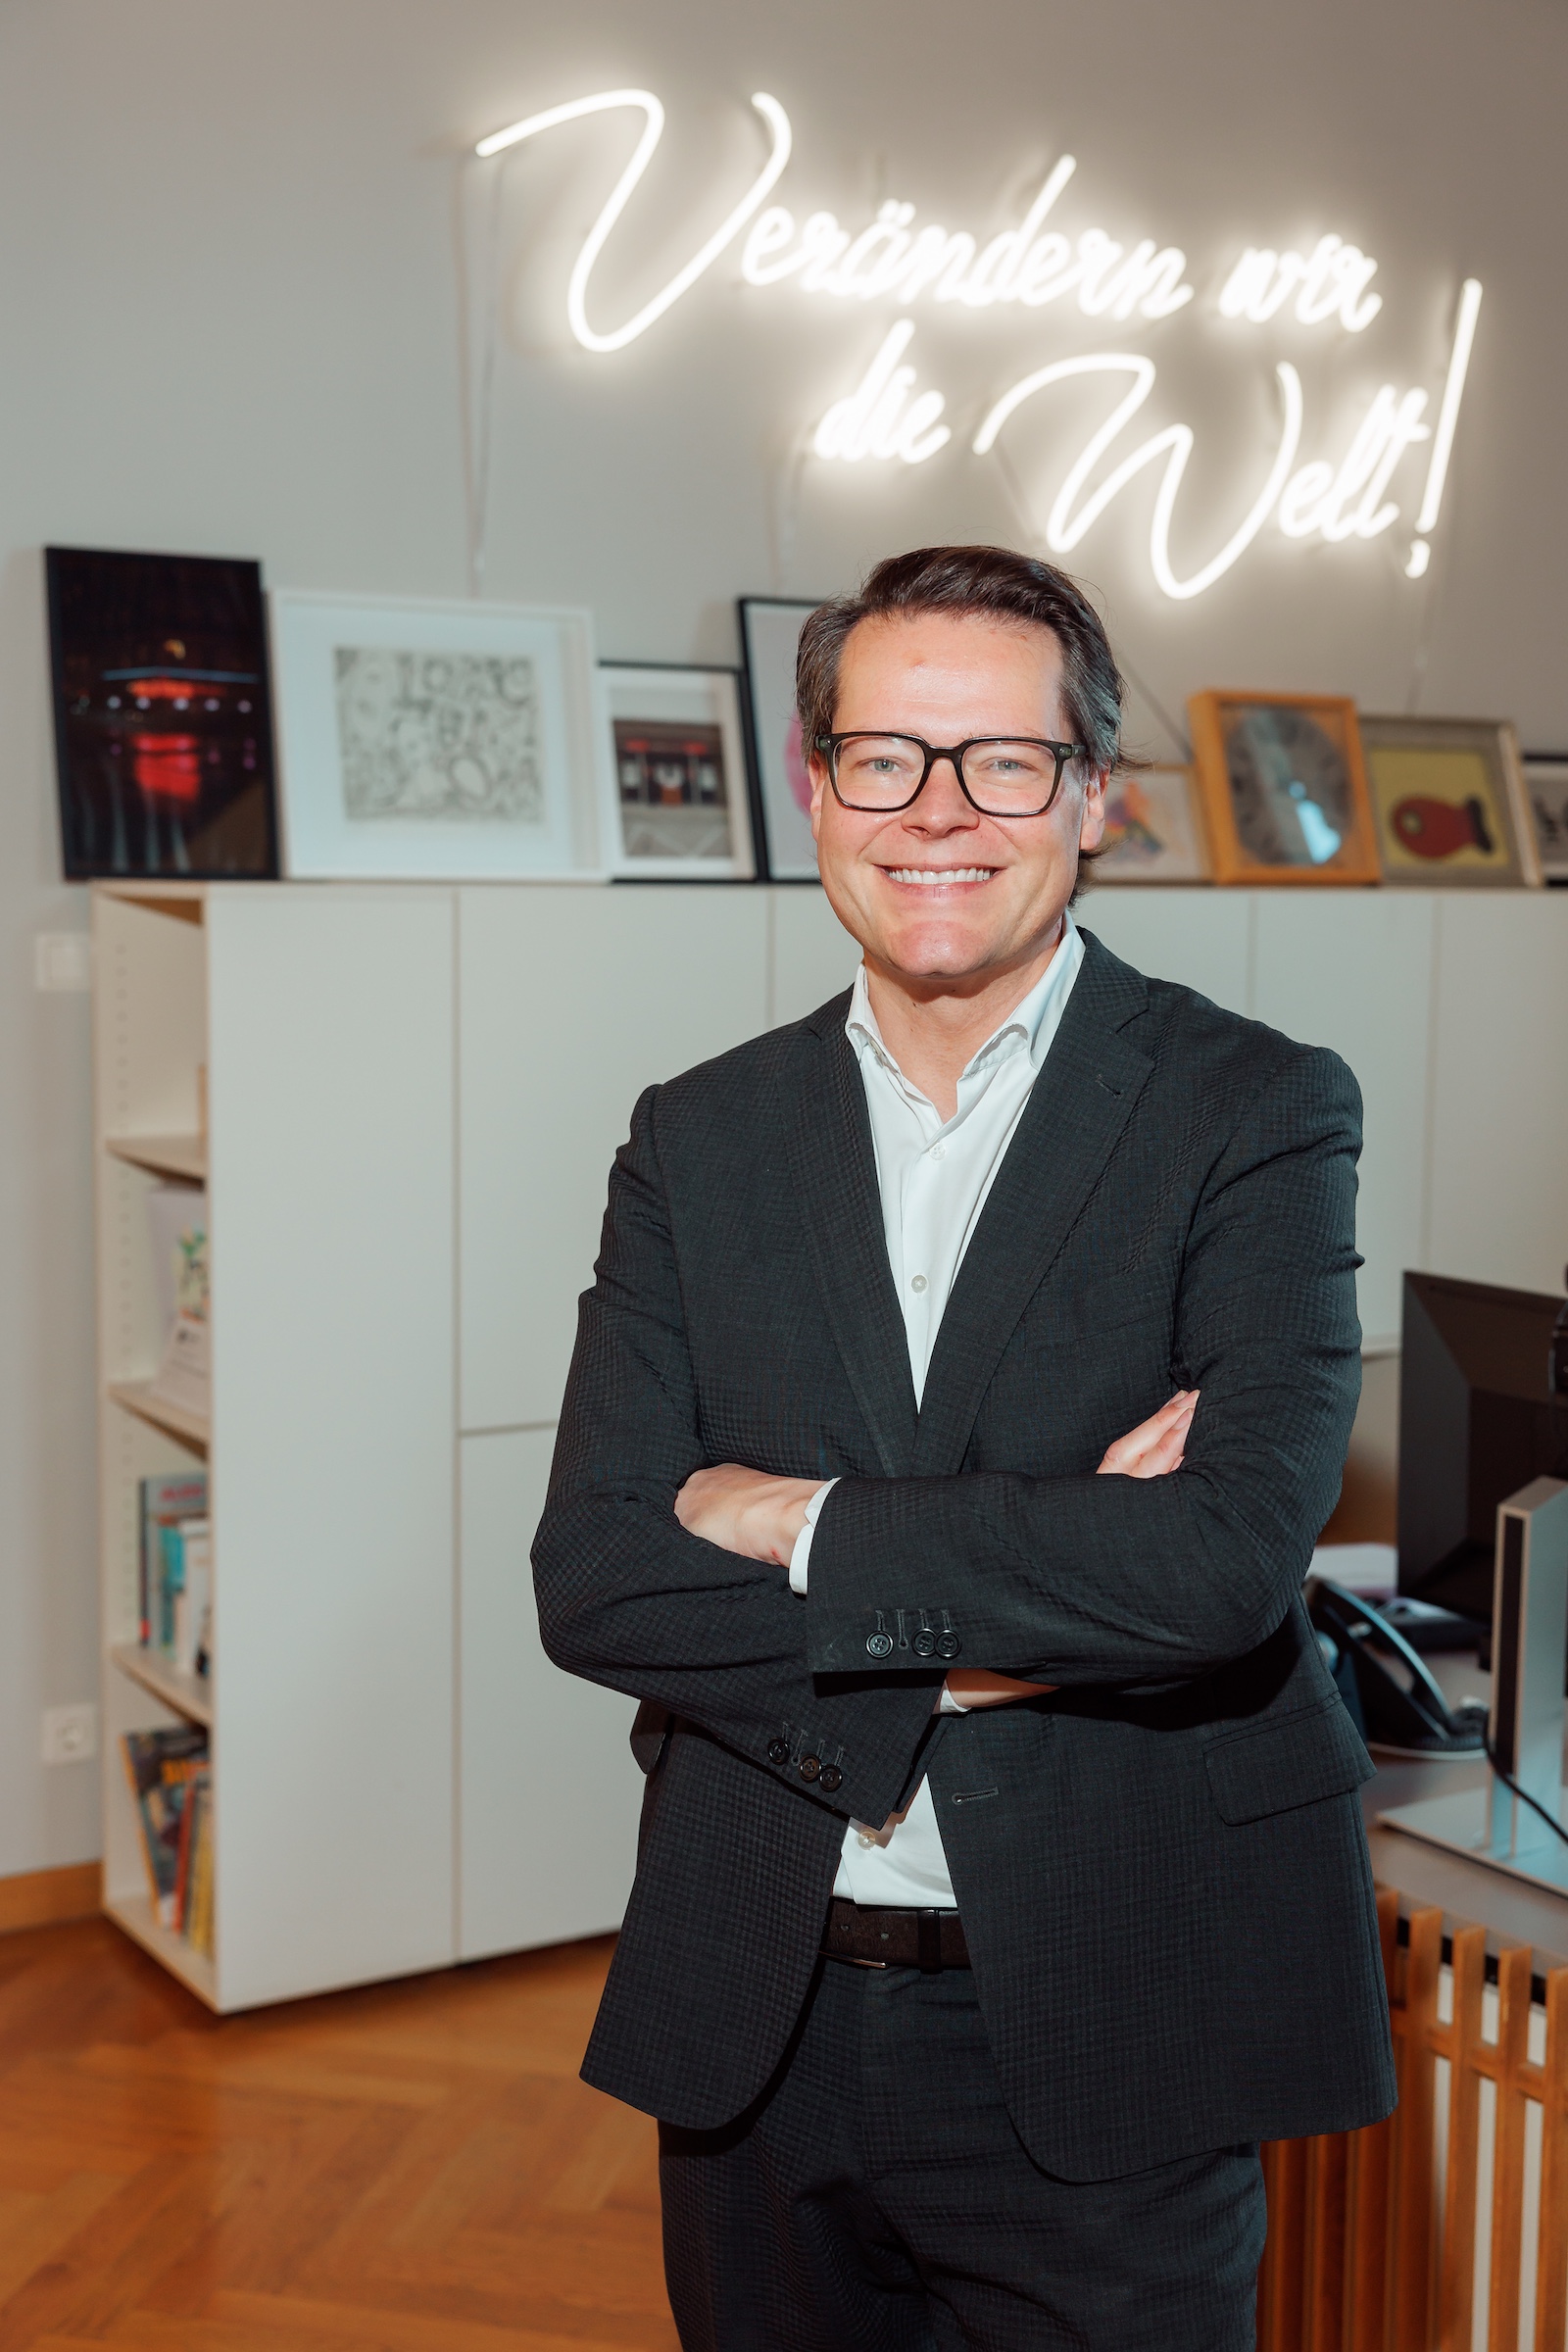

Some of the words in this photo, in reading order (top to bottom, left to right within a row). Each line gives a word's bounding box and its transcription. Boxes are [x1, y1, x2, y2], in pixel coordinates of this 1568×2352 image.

[476, 88, 1192, 352] Verändern
[1219, 235, 1381, 331] wir
[812, 318, 950, 464] die
[974, 277, 1481, 598] Welt!
